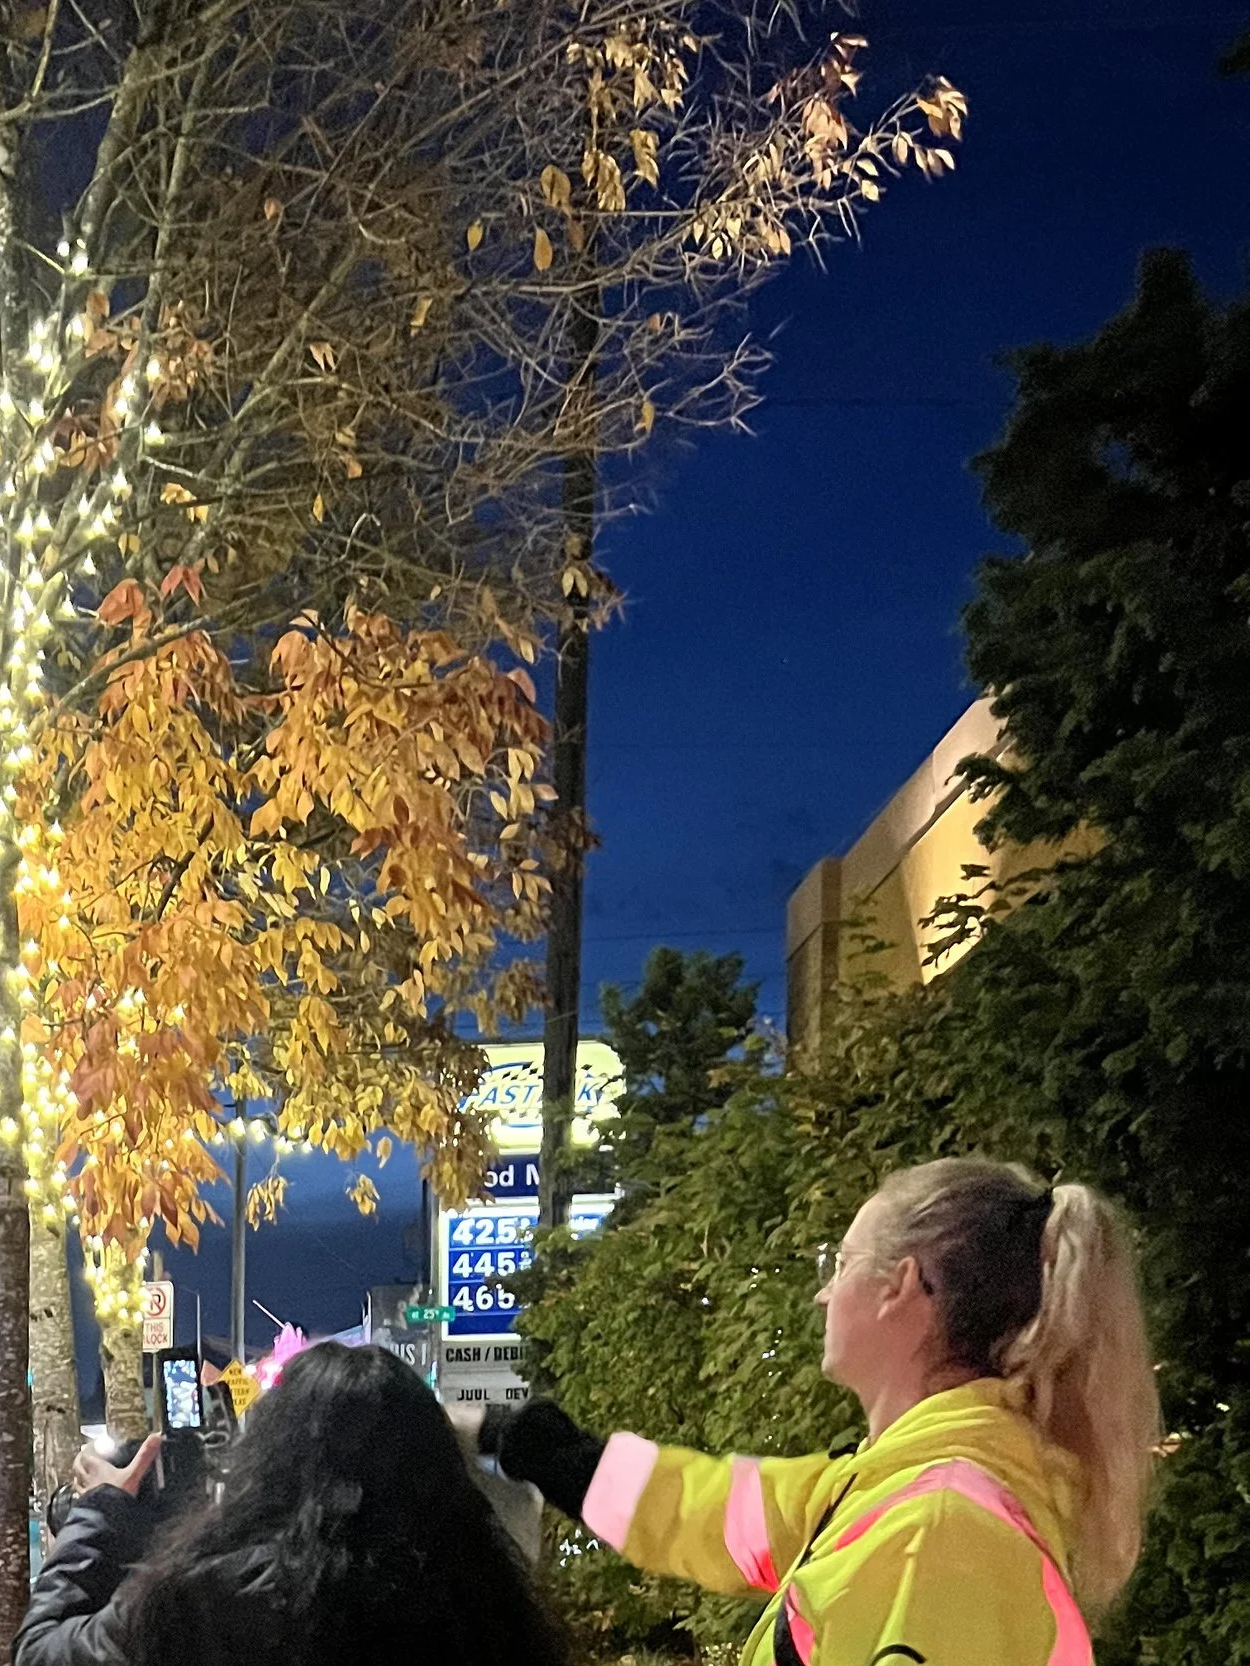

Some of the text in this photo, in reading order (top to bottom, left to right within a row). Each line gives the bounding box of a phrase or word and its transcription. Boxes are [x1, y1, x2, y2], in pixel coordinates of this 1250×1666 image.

[452, 1252, 515, 1277] 445
[143, 1333, 168, 1345] LOCK
[446, 1348, 481, 1362] CASH
[494, 1347, 525, 1361] DEBI
[457, 1388, 490, 1401] JUUL
